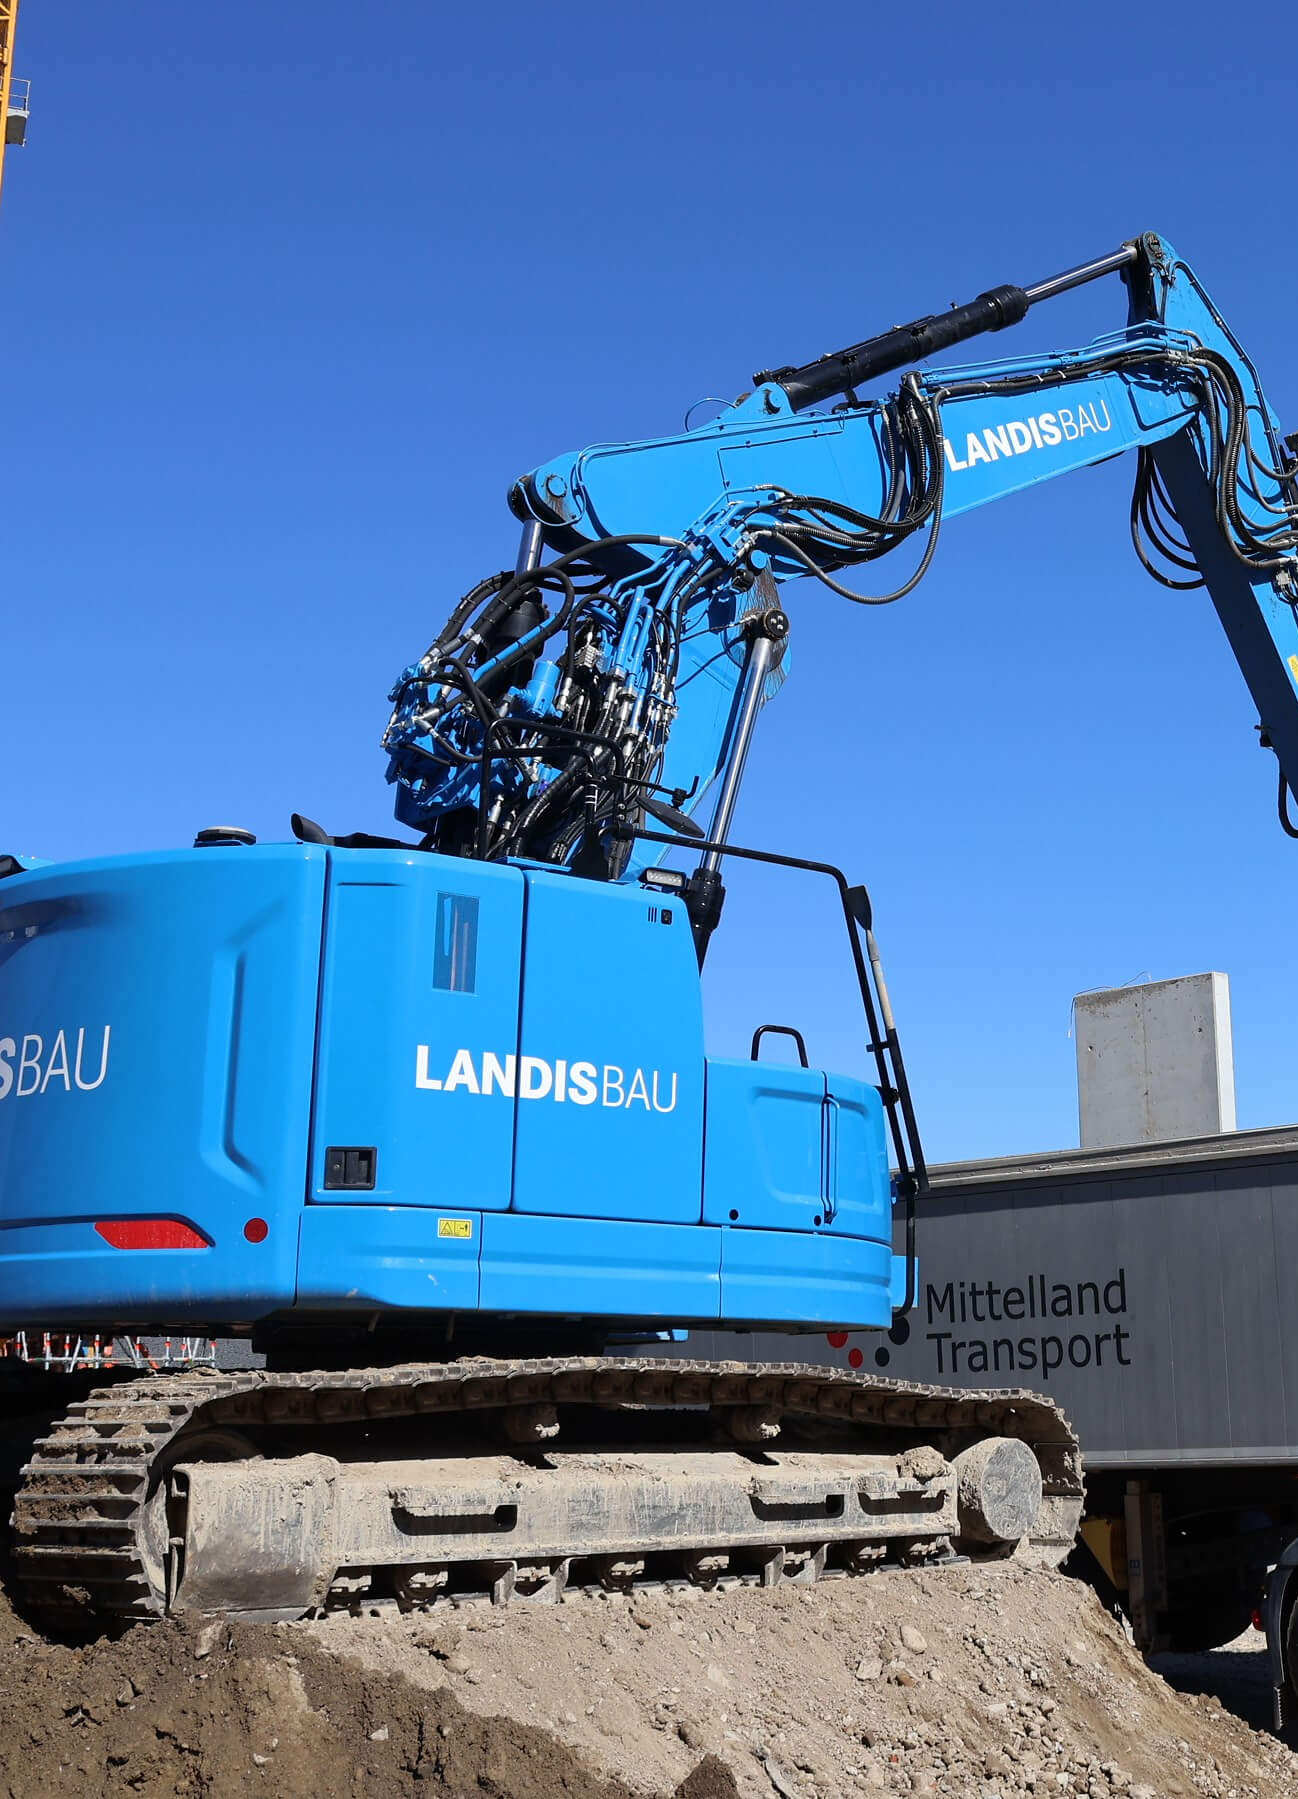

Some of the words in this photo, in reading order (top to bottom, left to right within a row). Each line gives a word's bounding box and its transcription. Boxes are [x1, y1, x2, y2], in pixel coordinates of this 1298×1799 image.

[943, 399, 1112, 472] LANDISBAU
[415, 1044, 678, 1113] LANDISBAU
[926, 1268, 1127, 1325] Mittelland
[926, 1324, 1131, 1381] Transport
